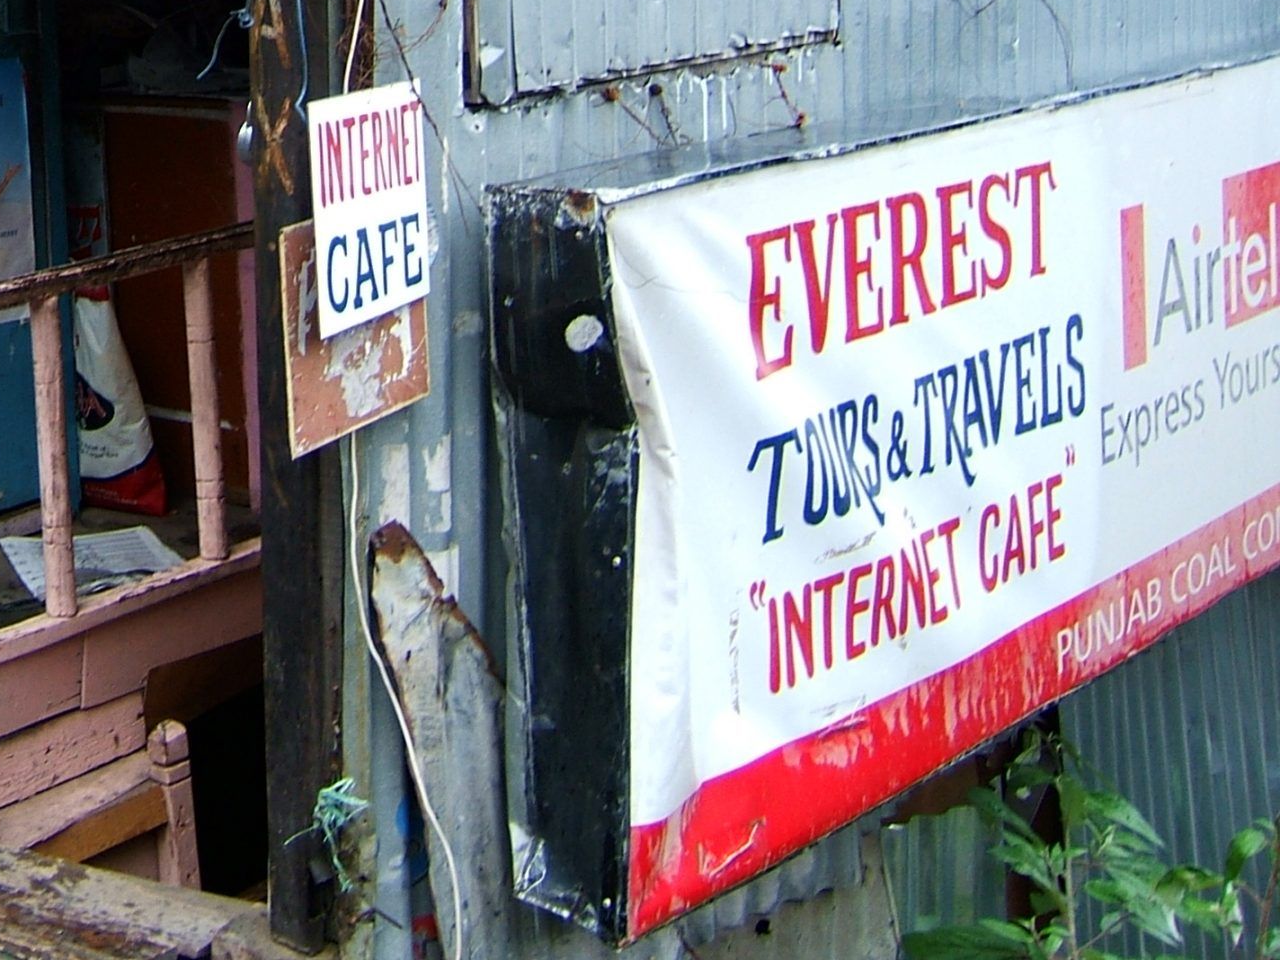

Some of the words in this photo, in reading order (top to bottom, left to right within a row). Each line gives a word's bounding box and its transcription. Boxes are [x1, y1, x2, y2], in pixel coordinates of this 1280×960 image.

[318, 101, 422, 209] INTERNET
[326, 212, 423, 314] CAFE
[745, 161, 1057, 381] EVEREST
[1153, 201, 1279, 347] Airtel
[1100, 378, 1205, 468] Express
[1056, 577, 1163, 674] PUNJAB
[1171, 535, 1236, 605] COAL
